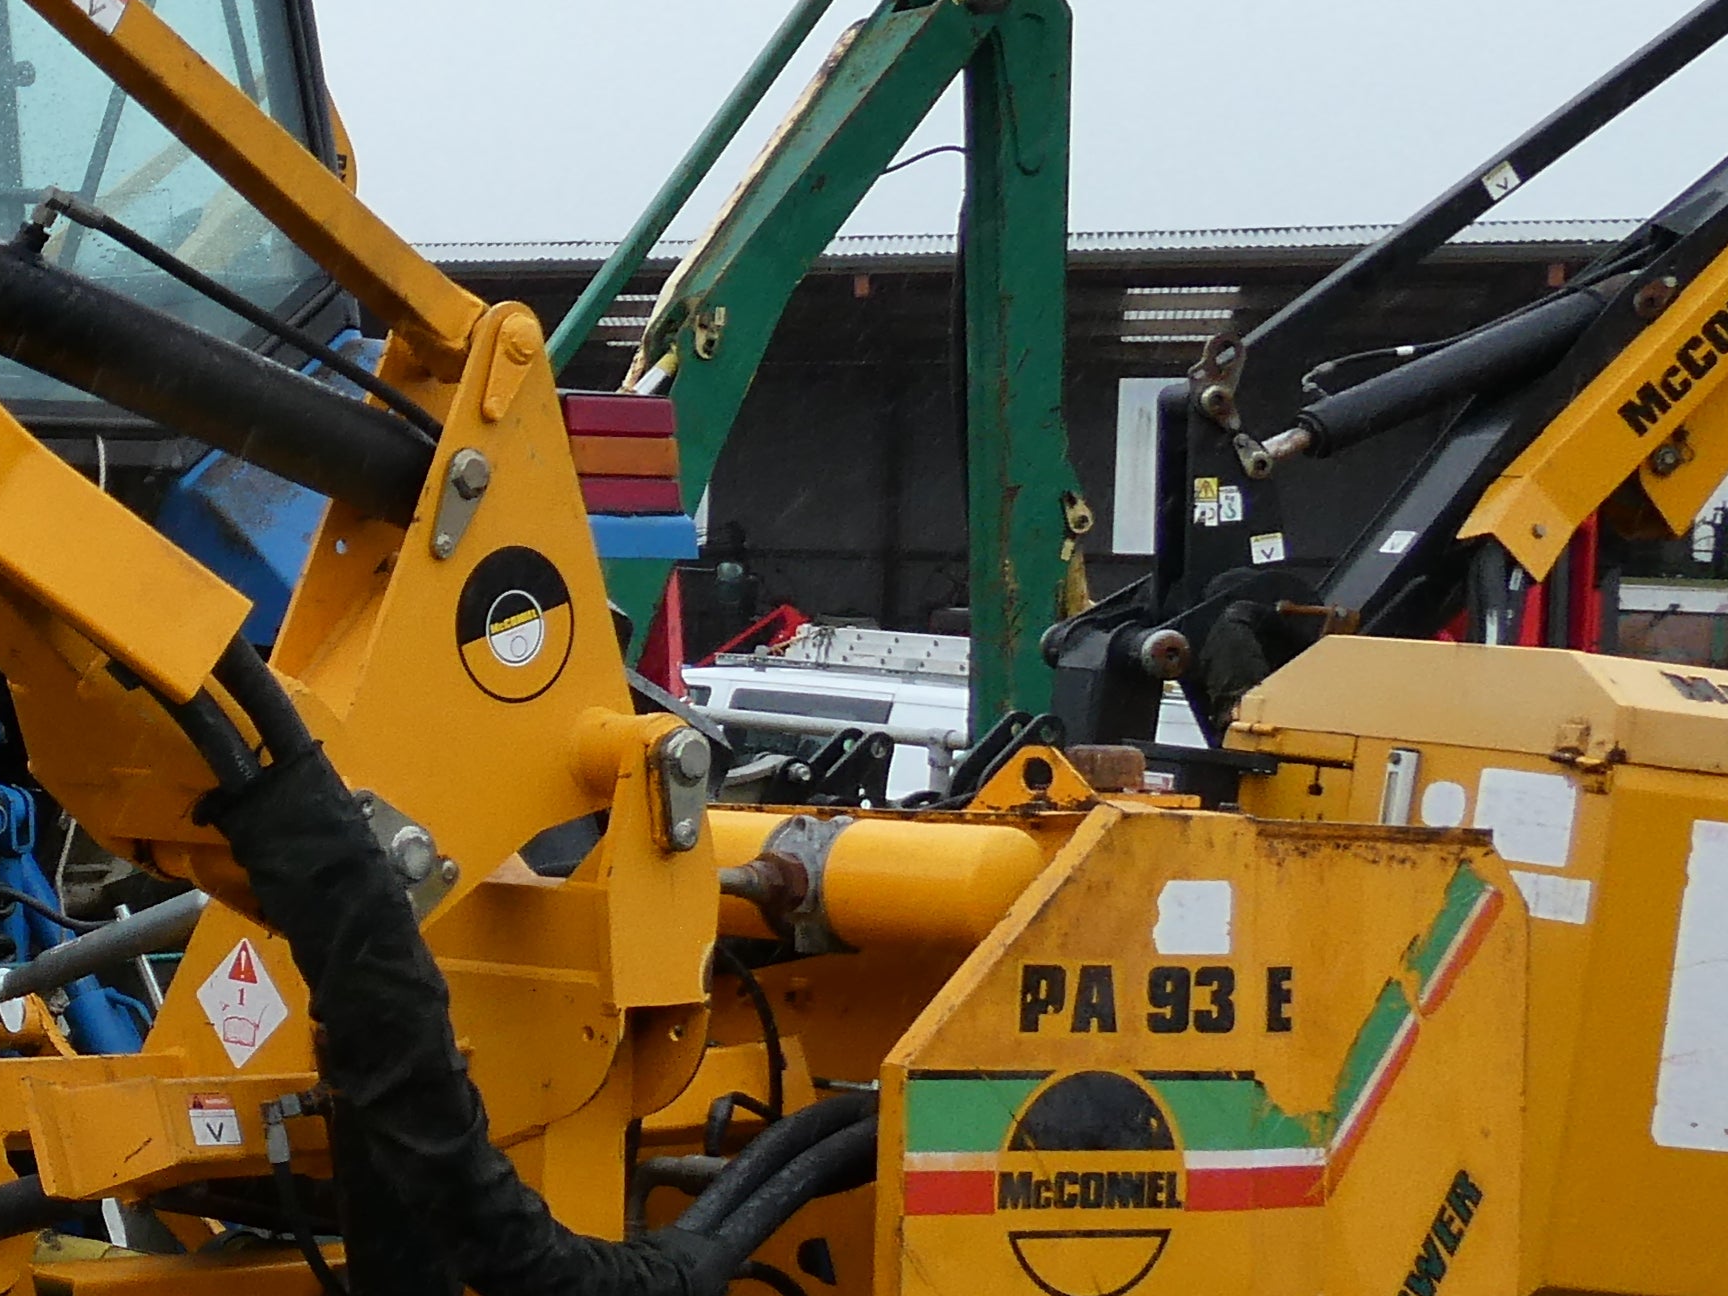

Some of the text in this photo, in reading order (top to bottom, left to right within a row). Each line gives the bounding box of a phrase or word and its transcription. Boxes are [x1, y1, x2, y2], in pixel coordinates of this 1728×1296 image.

[1617, 300, 1728, 438] McCO
[1019, 964, 1293, 1034] PA 93 E
[997, 1170, 1184, 1210] McCONNEL
